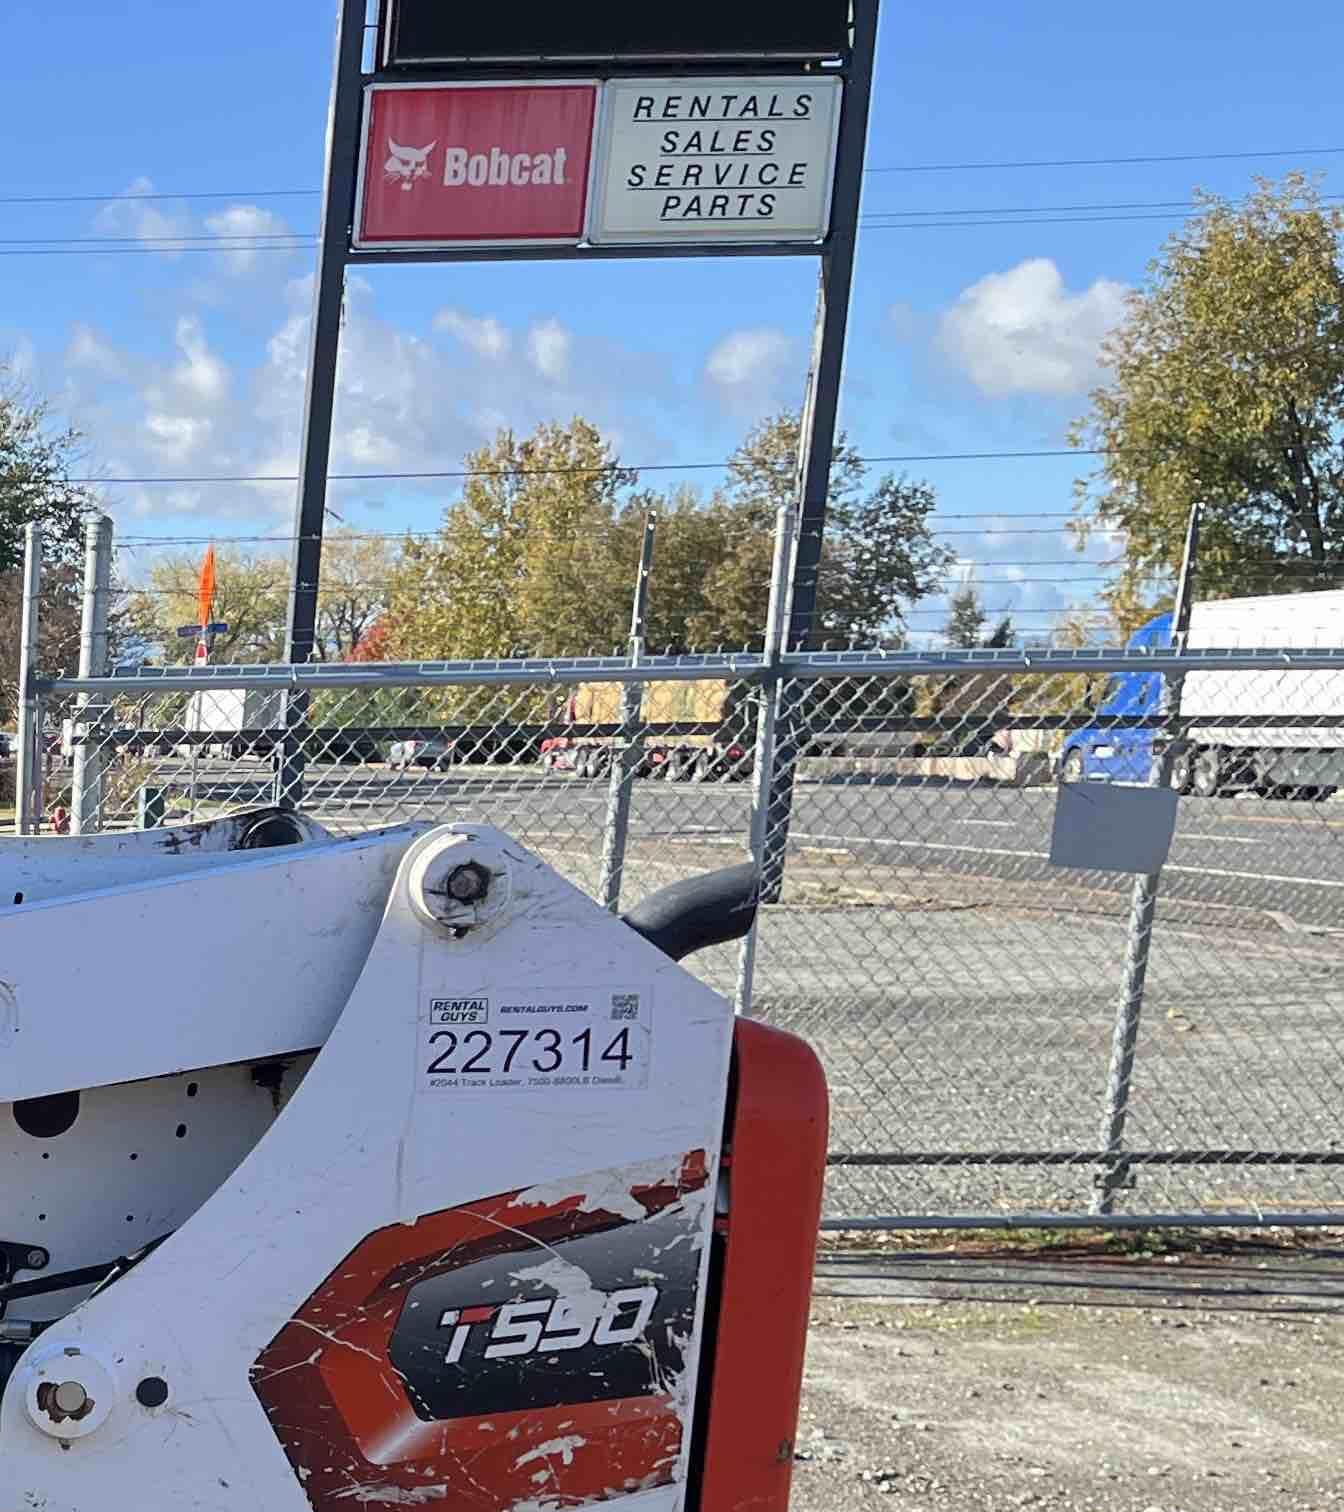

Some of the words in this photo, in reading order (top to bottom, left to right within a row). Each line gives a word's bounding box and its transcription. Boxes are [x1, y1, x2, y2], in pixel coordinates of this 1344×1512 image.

[632, 94, 812, 119] RENTALS
[660, 130, 777, 153] SALES
[443, 147, 567, 186] Bobcat
[627, 163, 808, 187] SERVICE
[661, 194, 777, 217] PARTS
[433, 1001, 484, 1011] RENTAL
[440, 1011, 478, 1022] GUYS
[427, 1027, 633, 1074] 227314
[440, 1286, 659, 1364] T590
